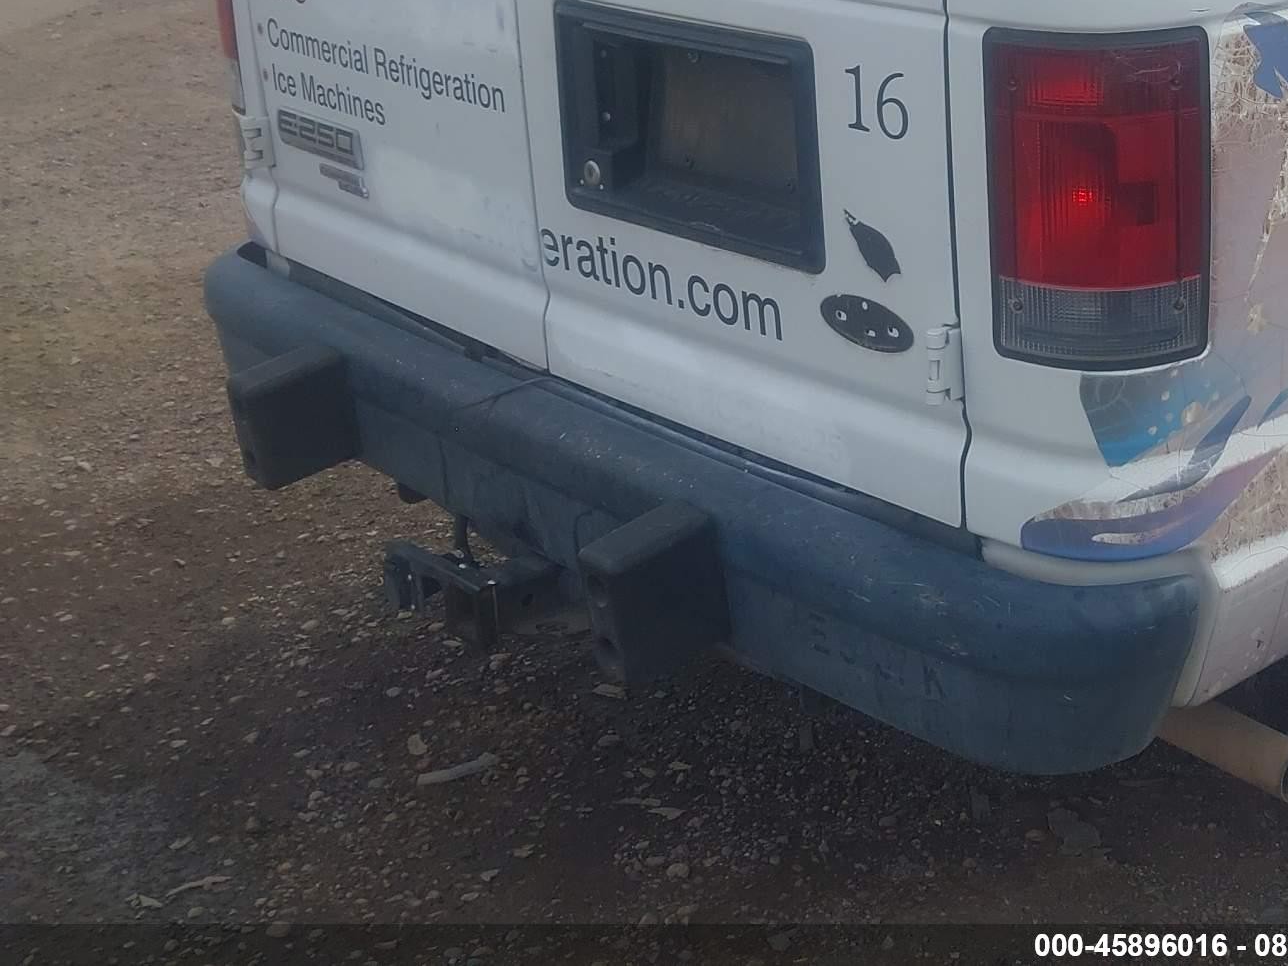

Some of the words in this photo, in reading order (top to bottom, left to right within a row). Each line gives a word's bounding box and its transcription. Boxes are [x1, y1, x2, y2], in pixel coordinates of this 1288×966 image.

[267, 17, 369, 74] Commercial
[374, 47, 505, 113] Refrigeration
[272, 63, 297, 97] Ice
[300, 72, 386, 125] Machines
[844, 64, 910, 140] 16
[540, 228, 783, 341] eration.com
